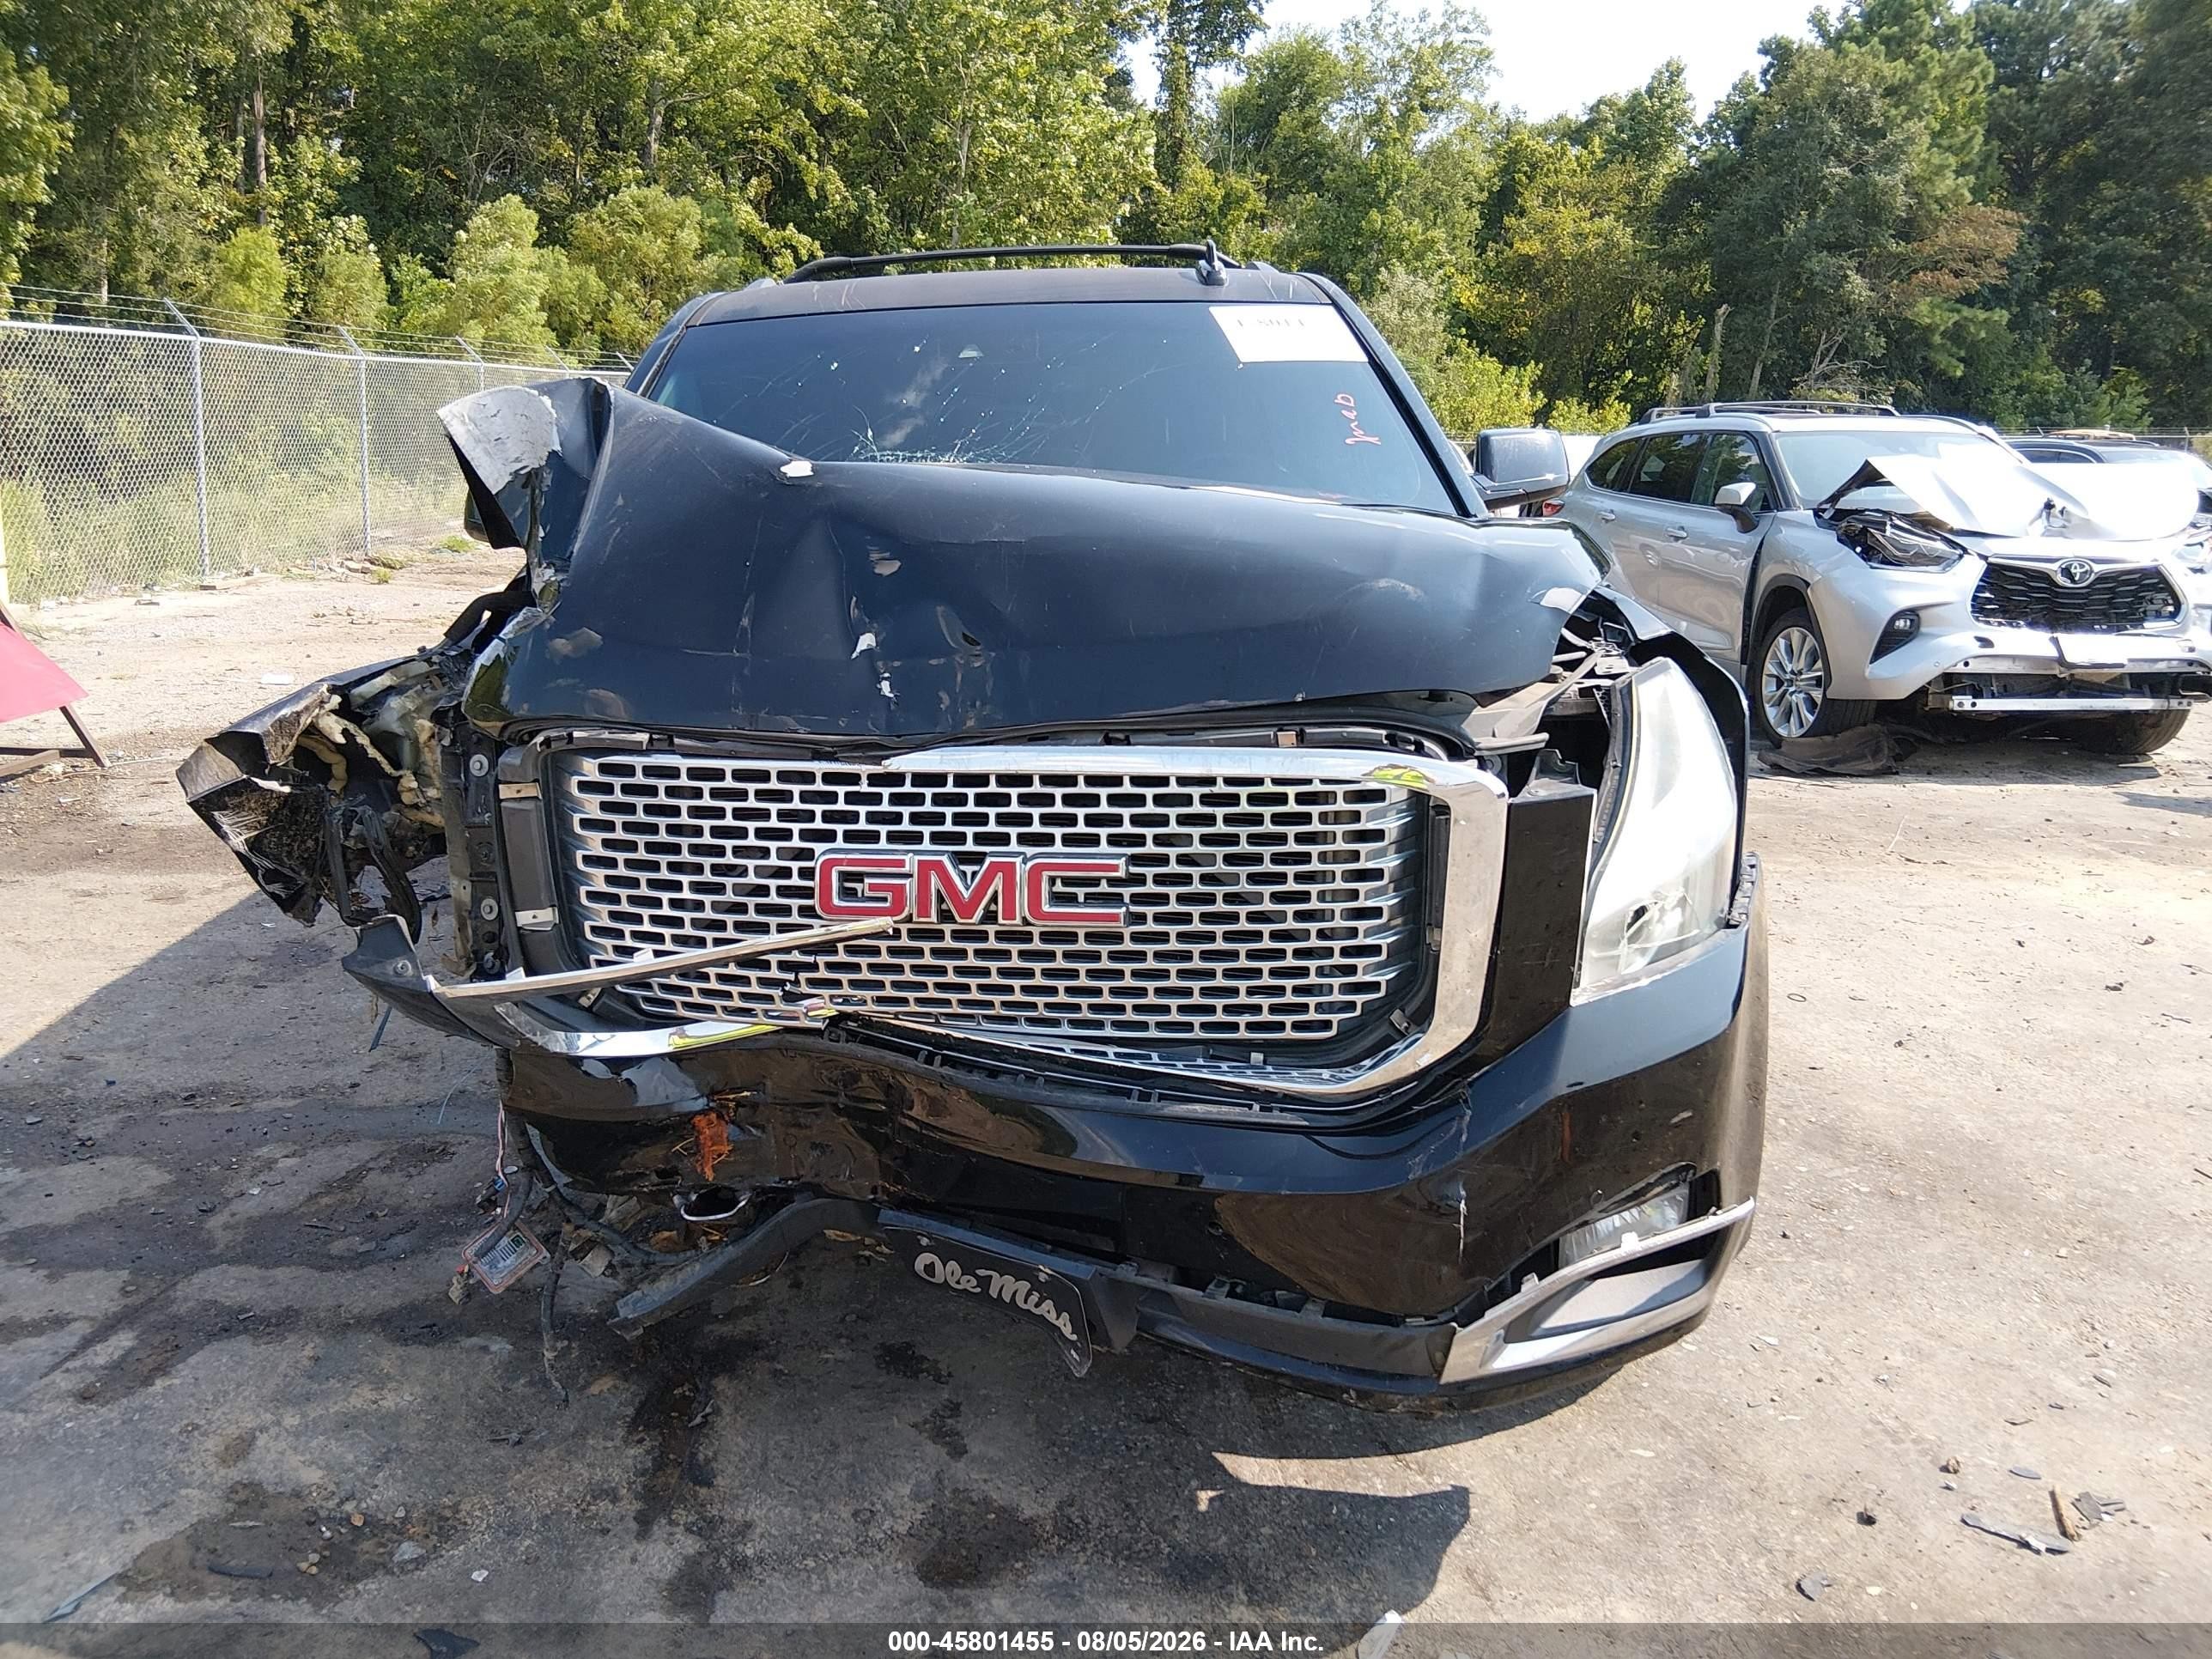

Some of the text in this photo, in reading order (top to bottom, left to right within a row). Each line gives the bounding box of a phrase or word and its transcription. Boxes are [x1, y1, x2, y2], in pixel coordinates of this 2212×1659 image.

[815, 848, 1130, 927] GMC
[914, 1251, 1079, 1341] Ole Miss
